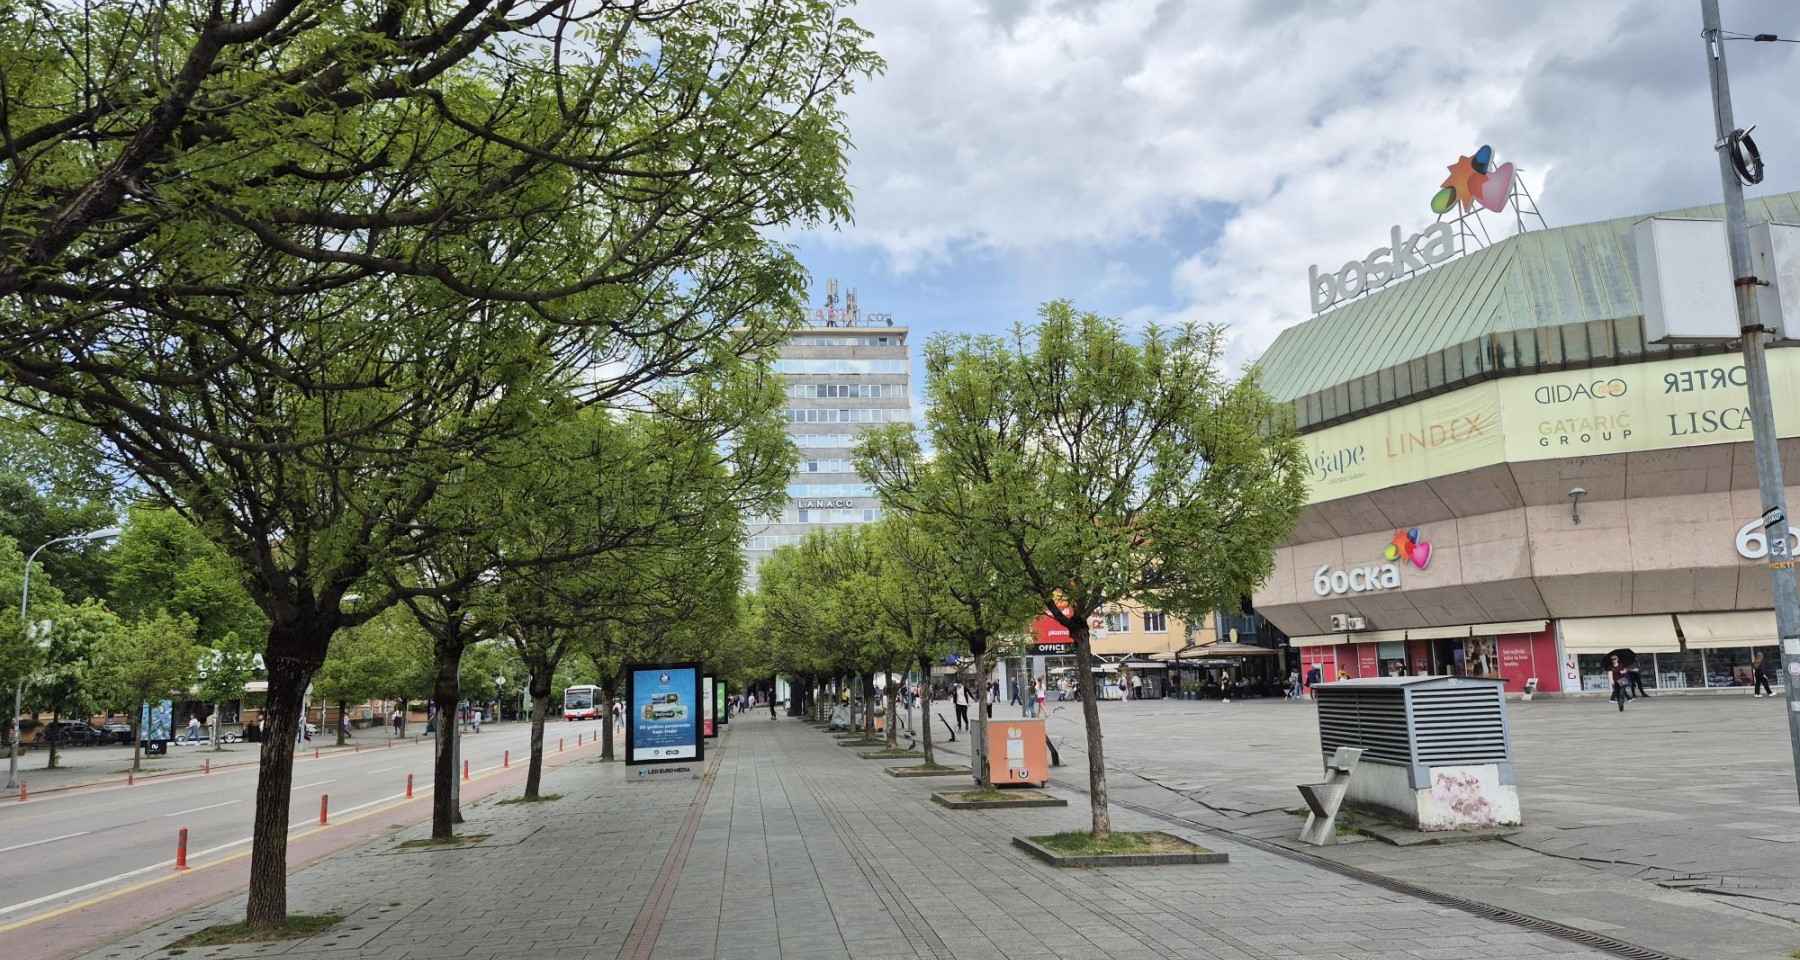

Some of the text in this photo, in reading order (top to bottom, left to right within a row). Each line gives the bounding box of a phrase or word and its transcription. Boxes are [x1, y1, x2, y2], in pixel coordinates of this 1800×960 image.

[1308, 221, 1454, 314] boska
[1384, 414, 1483, 459] LINDEX
[1538, 410, 1631, 436] GATARIĆ
[1667, 406, 1753, 437] LISCA
[1539, 429, 1632, 447] GROUP
[798, 499, 854, 509] LANACO
[1313, 563, 1401, 597] боска
